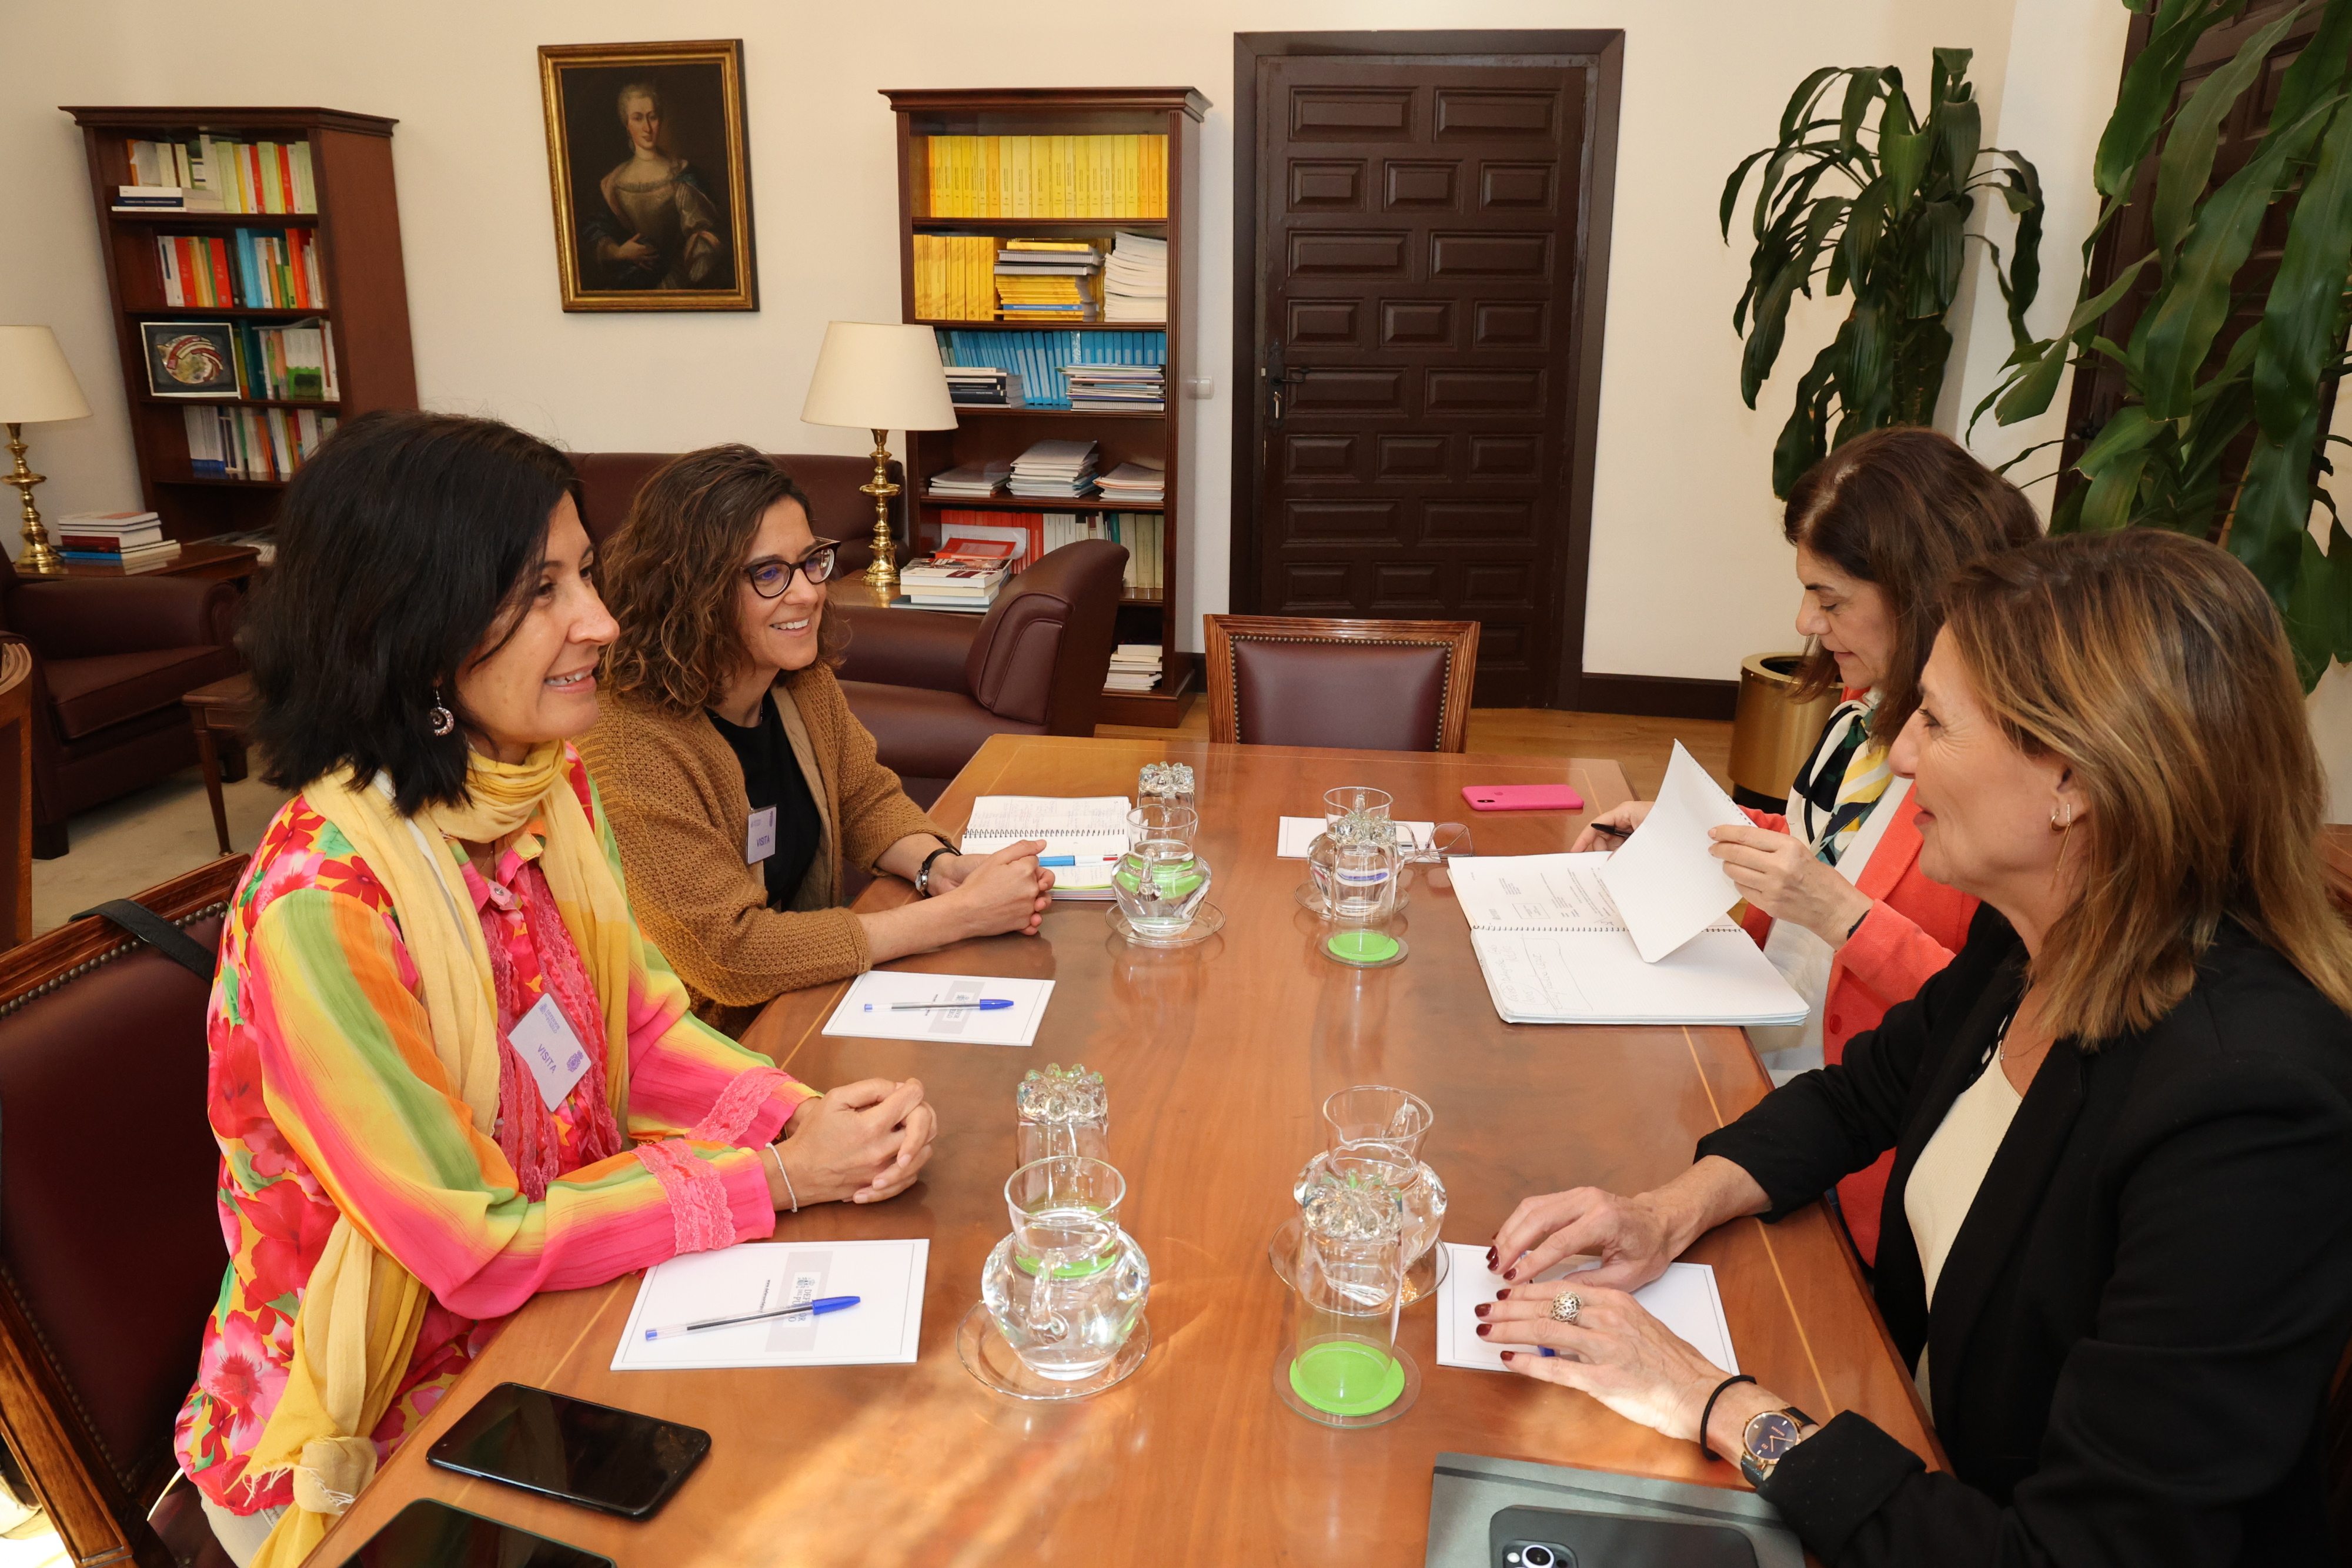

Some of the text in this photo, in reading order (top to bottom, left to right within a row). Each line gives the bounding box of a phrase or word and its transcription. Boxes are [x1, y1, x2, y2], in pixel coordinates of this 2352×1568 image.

[756, 835, 770, 847] VISITA
[546, 1008, 561, 1030] DEFENSOR
[546, 1017, 557, 1034] PUEBLO
[537, 1044, 557, 1074] VISITA
[788, 1296, 801, 1322] PUO
[798, 1289, 812, 1322] DEFEOR
